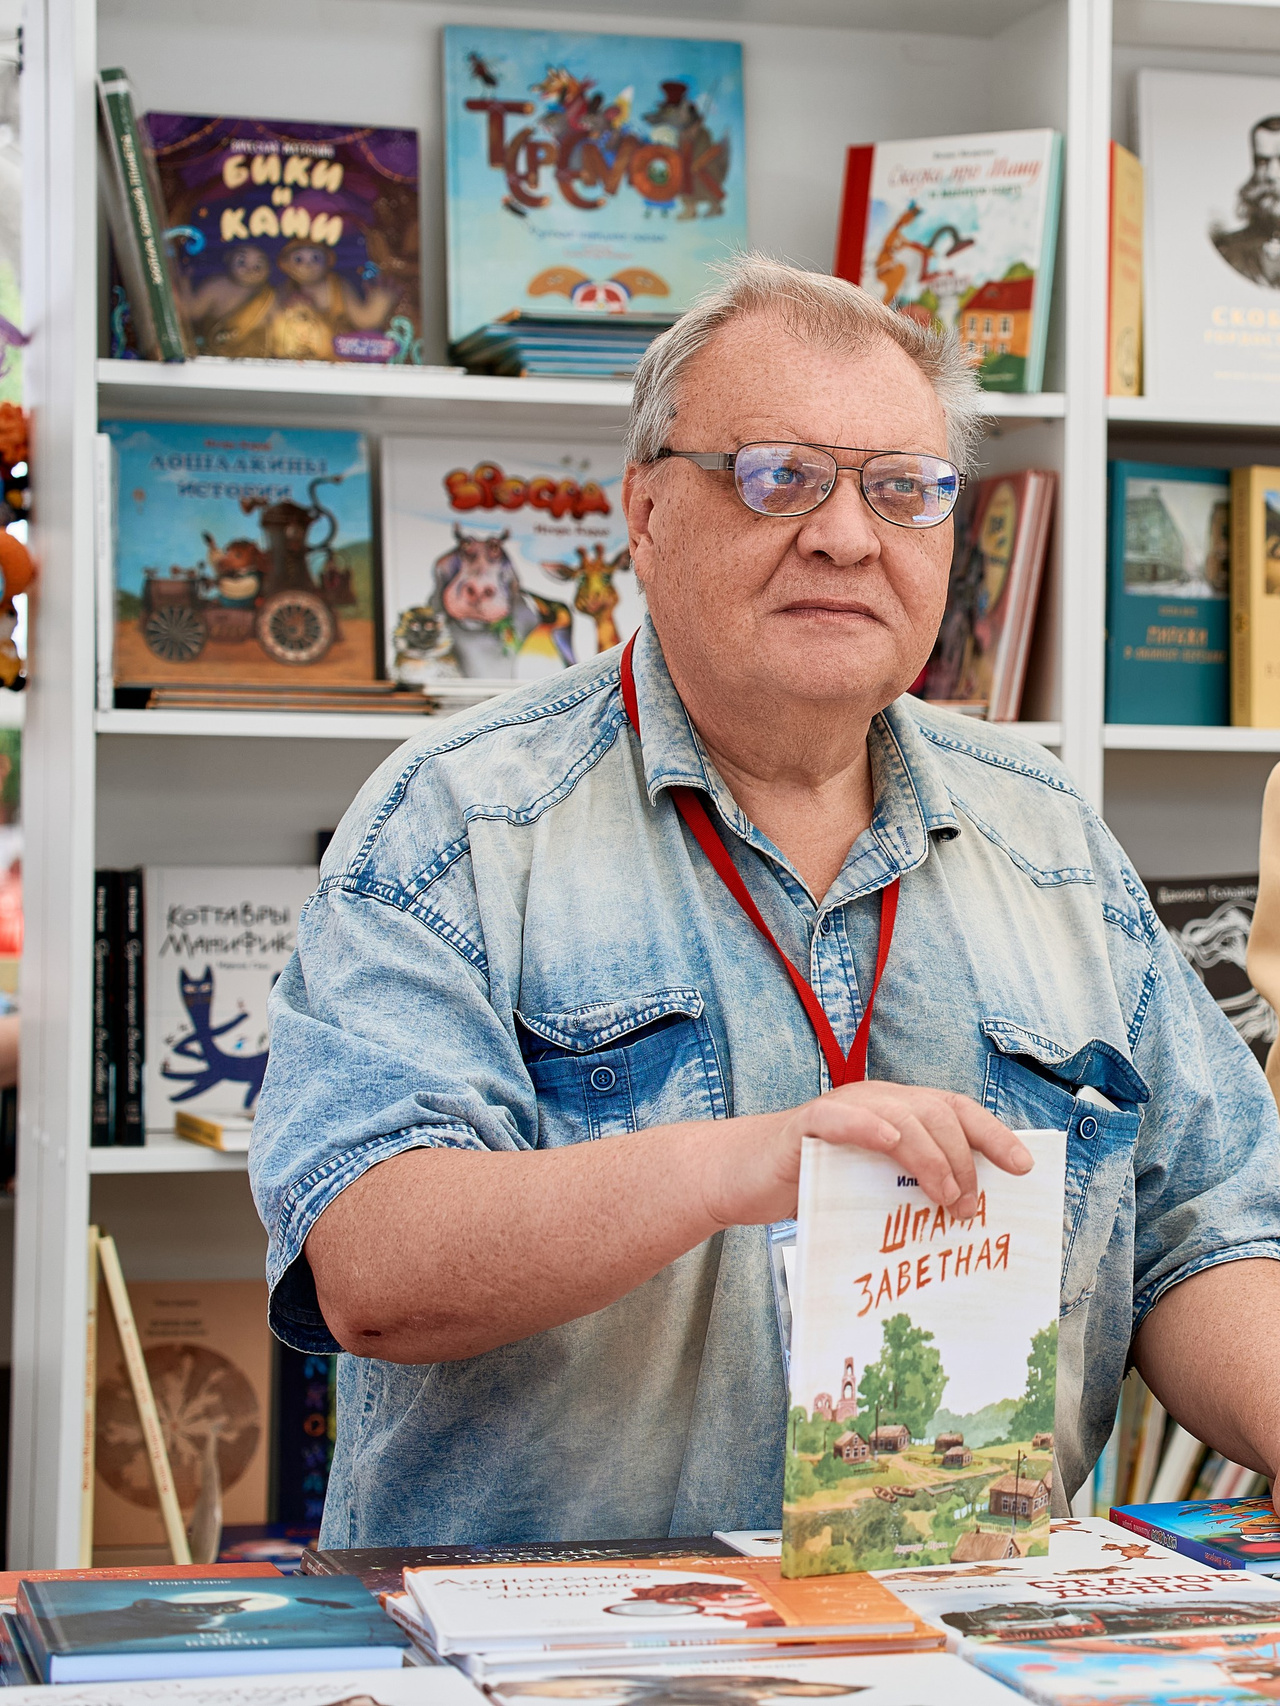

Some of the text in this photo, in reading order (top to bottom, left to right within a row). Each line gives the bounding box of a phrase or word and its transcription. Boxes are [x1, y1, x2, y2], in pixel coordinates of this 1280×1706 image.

[223, 154, 344, 193] БИКИ
[220, 205, 344, 246] КАНИ
[177, 482, 293, 500] ИСТОРИИ
[853, 1233, 1010, 1317] ЗАВЕТНАЯ
[1024, 1572, 1252, 1591] СТАРОЕ
[1044, 1581, 1215, 1599] ДЕПО
